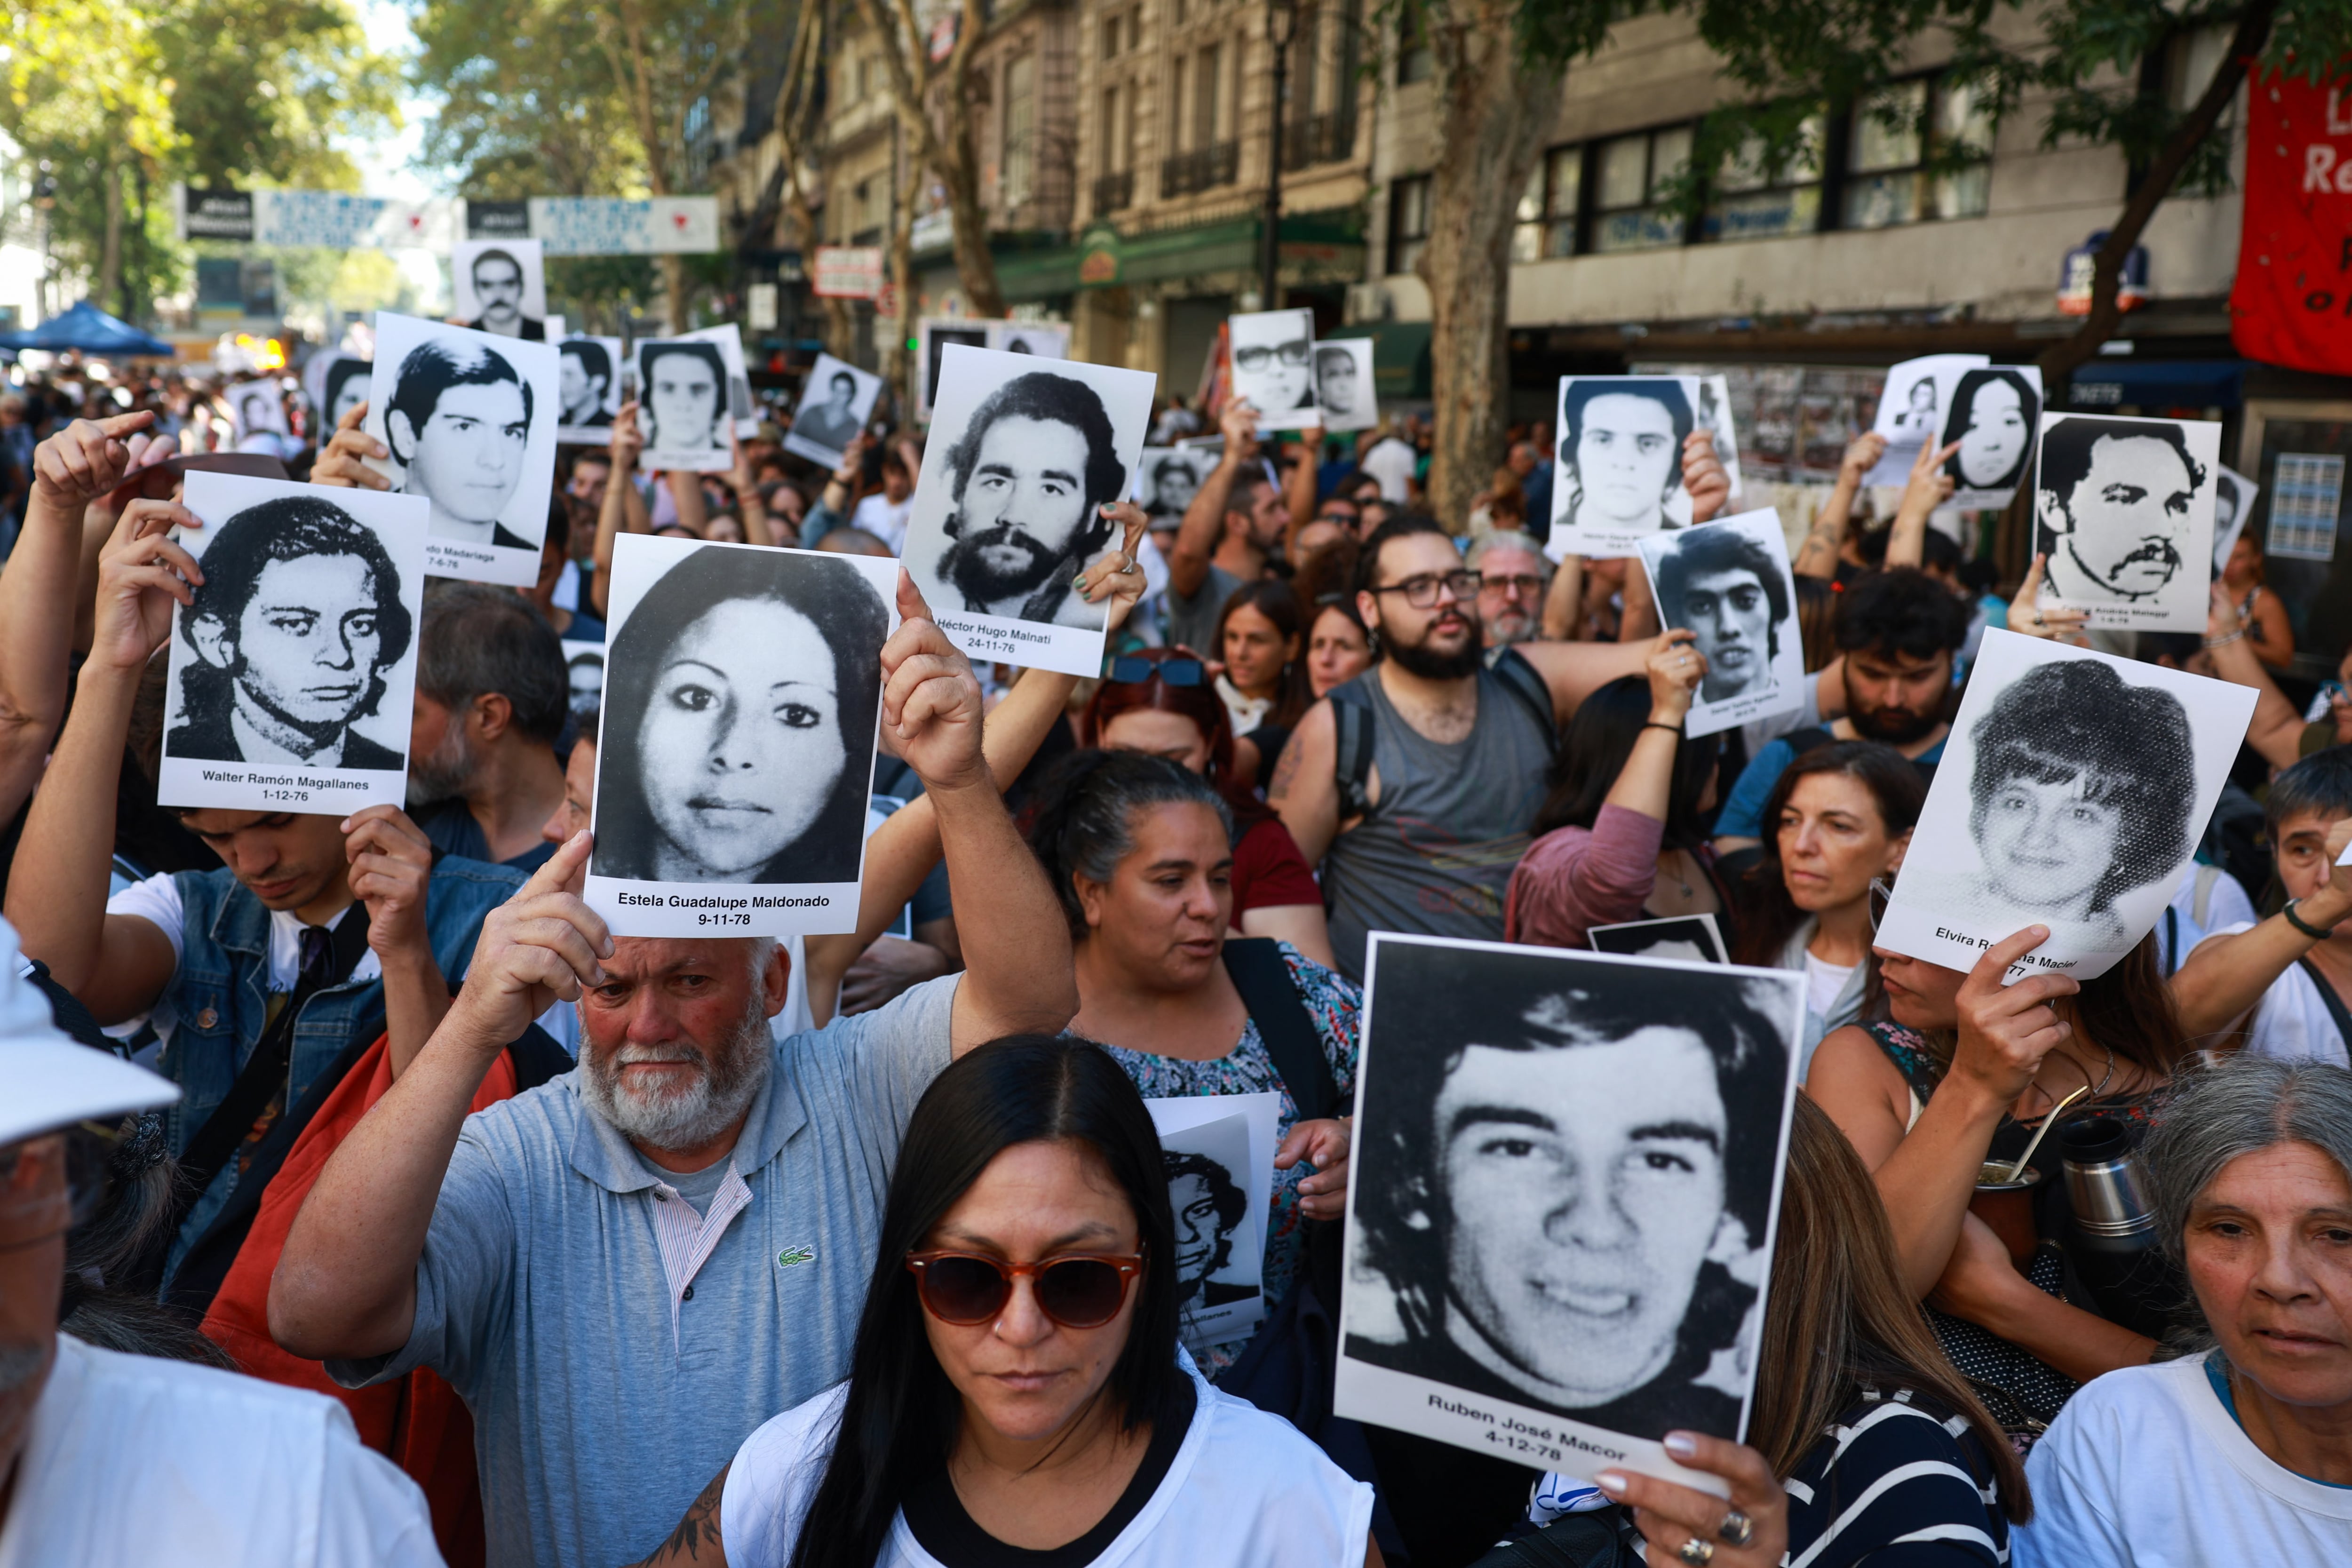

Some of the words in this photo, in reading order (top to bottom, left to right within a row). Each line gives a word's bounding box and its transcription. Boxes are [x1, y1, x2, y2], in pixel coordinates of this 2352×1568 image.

[444, 547, 494, 562] Madariaga
[938, 619, 974, 631] Héctor
[977, 624, 1007, 638] Hugo
[1010, 629, 1051, 644] Malnati
[968, 637, 1015, 653] 24-11-76
[203, 771, 244, 782] Walter
[248, 773, 293, 786] Ramón
[297, 777, 369, 790] Magallanes
[263, 789, 309, 802] 1-12-76
[618, 892, 664, 907] Estela
[668, 895, 748, 911] Guadalupe
[752, 896, 830, 907] Maldonado
[698, 914, 751, 925] 9-11-78
[1936, 927, 1975, 946] Elvira
[2039, 957, 2077, 968] Maciel
[1428, 1394, 1495, 1425] Ruben
[1501, 1417, 1552, 1440] José
[1558, 1433, 1628, 1462] Macor
[1485, 1431, 1562, 1462] 4-12-78
